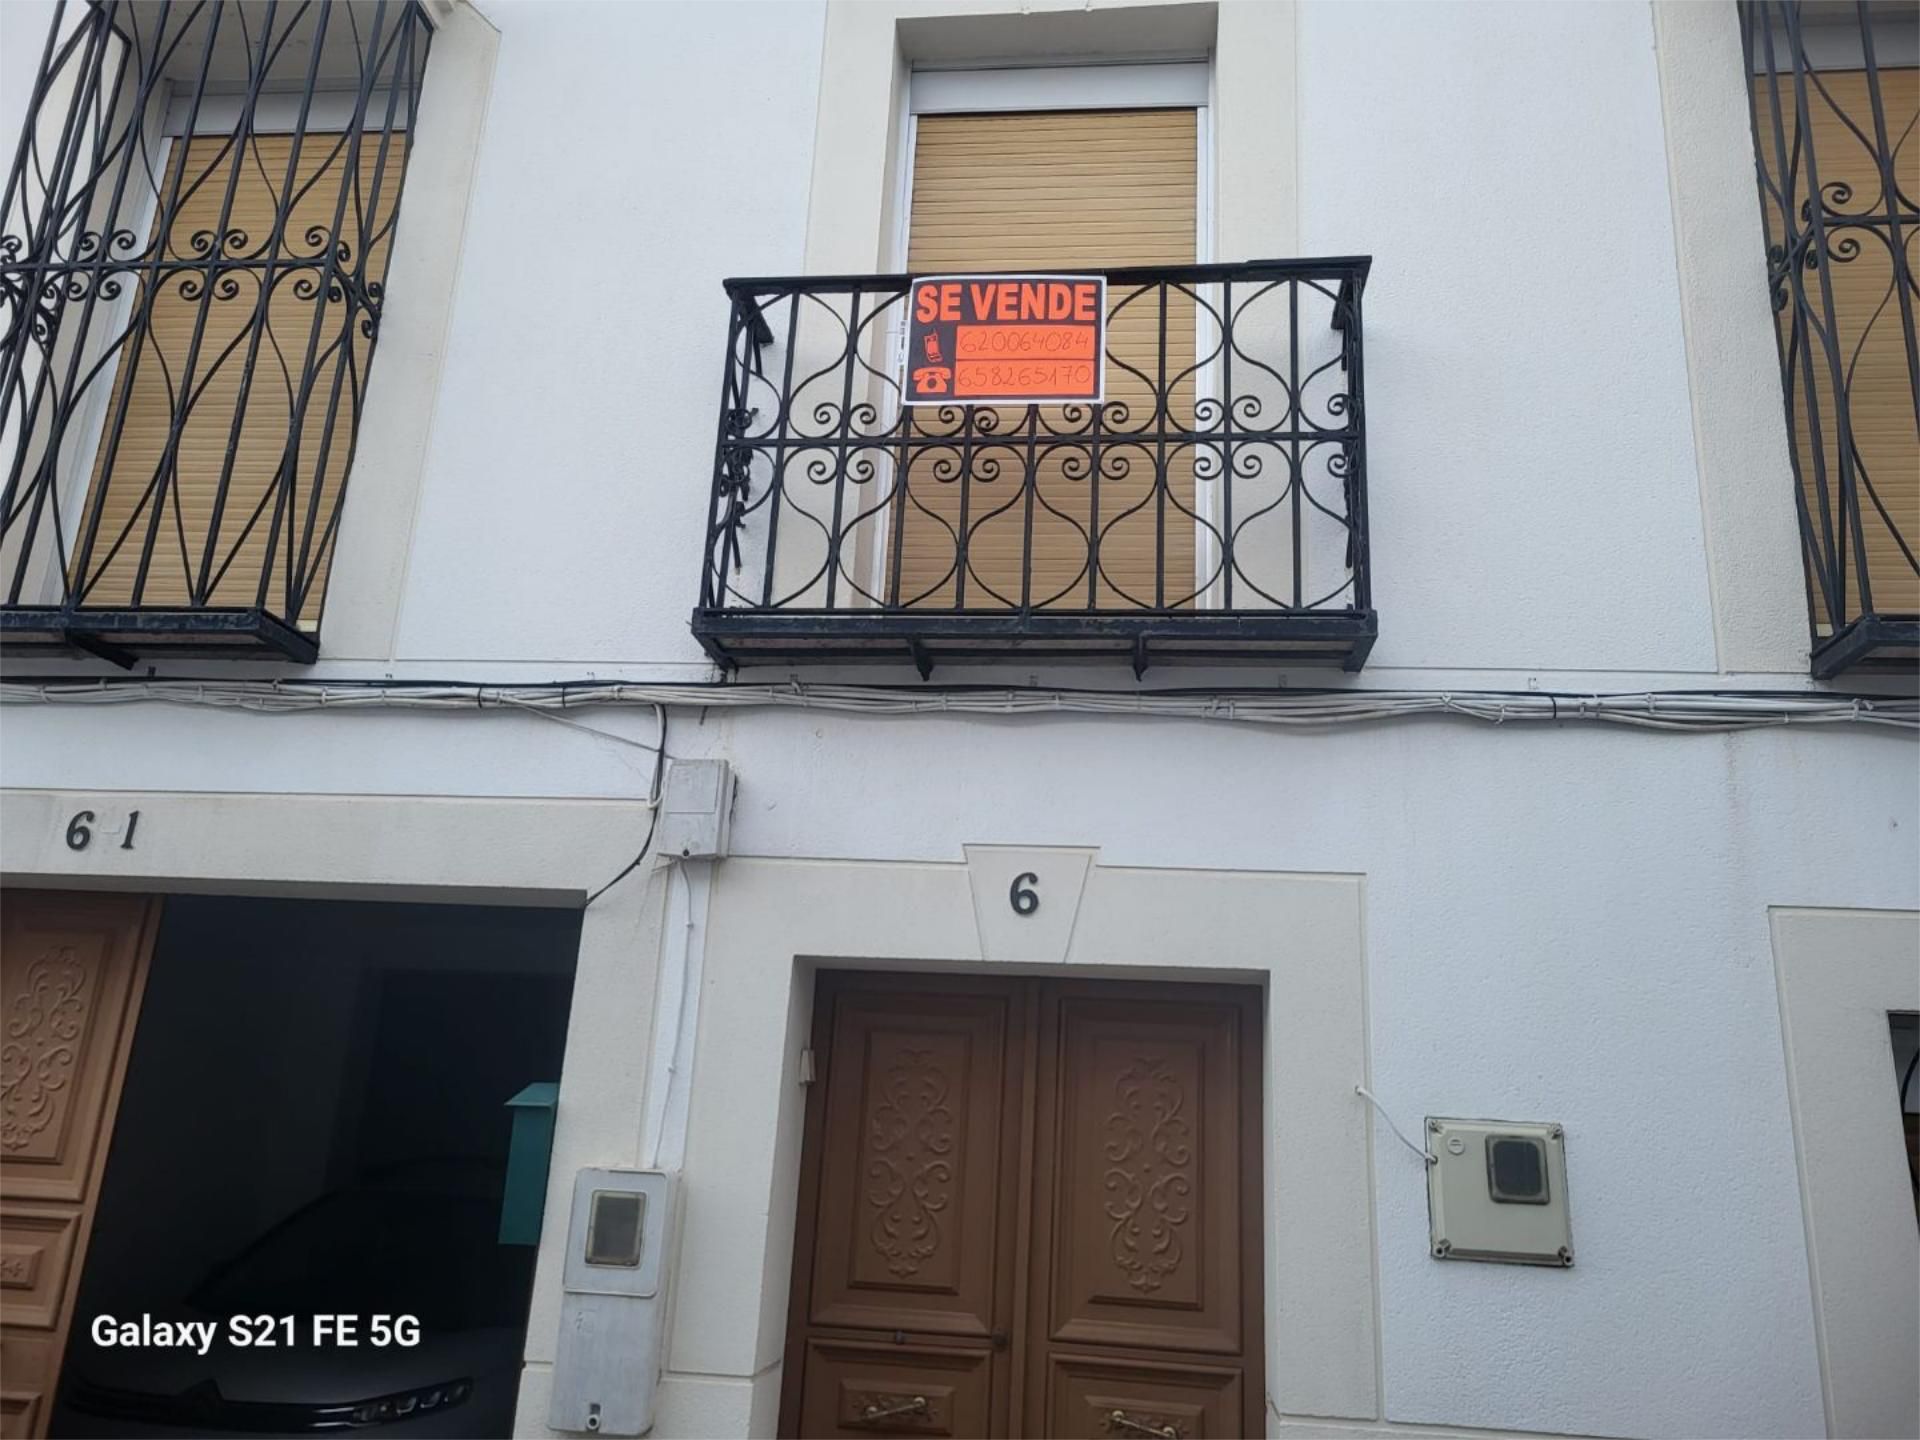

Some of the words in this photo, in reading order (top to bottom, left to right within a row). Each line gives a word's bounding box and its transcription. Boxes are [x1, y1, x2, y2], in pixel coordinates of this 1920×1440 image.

[916, 283, 963, 323] SE
[970, 283, 1097, 321] VENDE
[959, 330, 1090, 353] 620064084
[957, 364, 1092, 388] 658265170
[1009, 872, 1039, 916] 6
